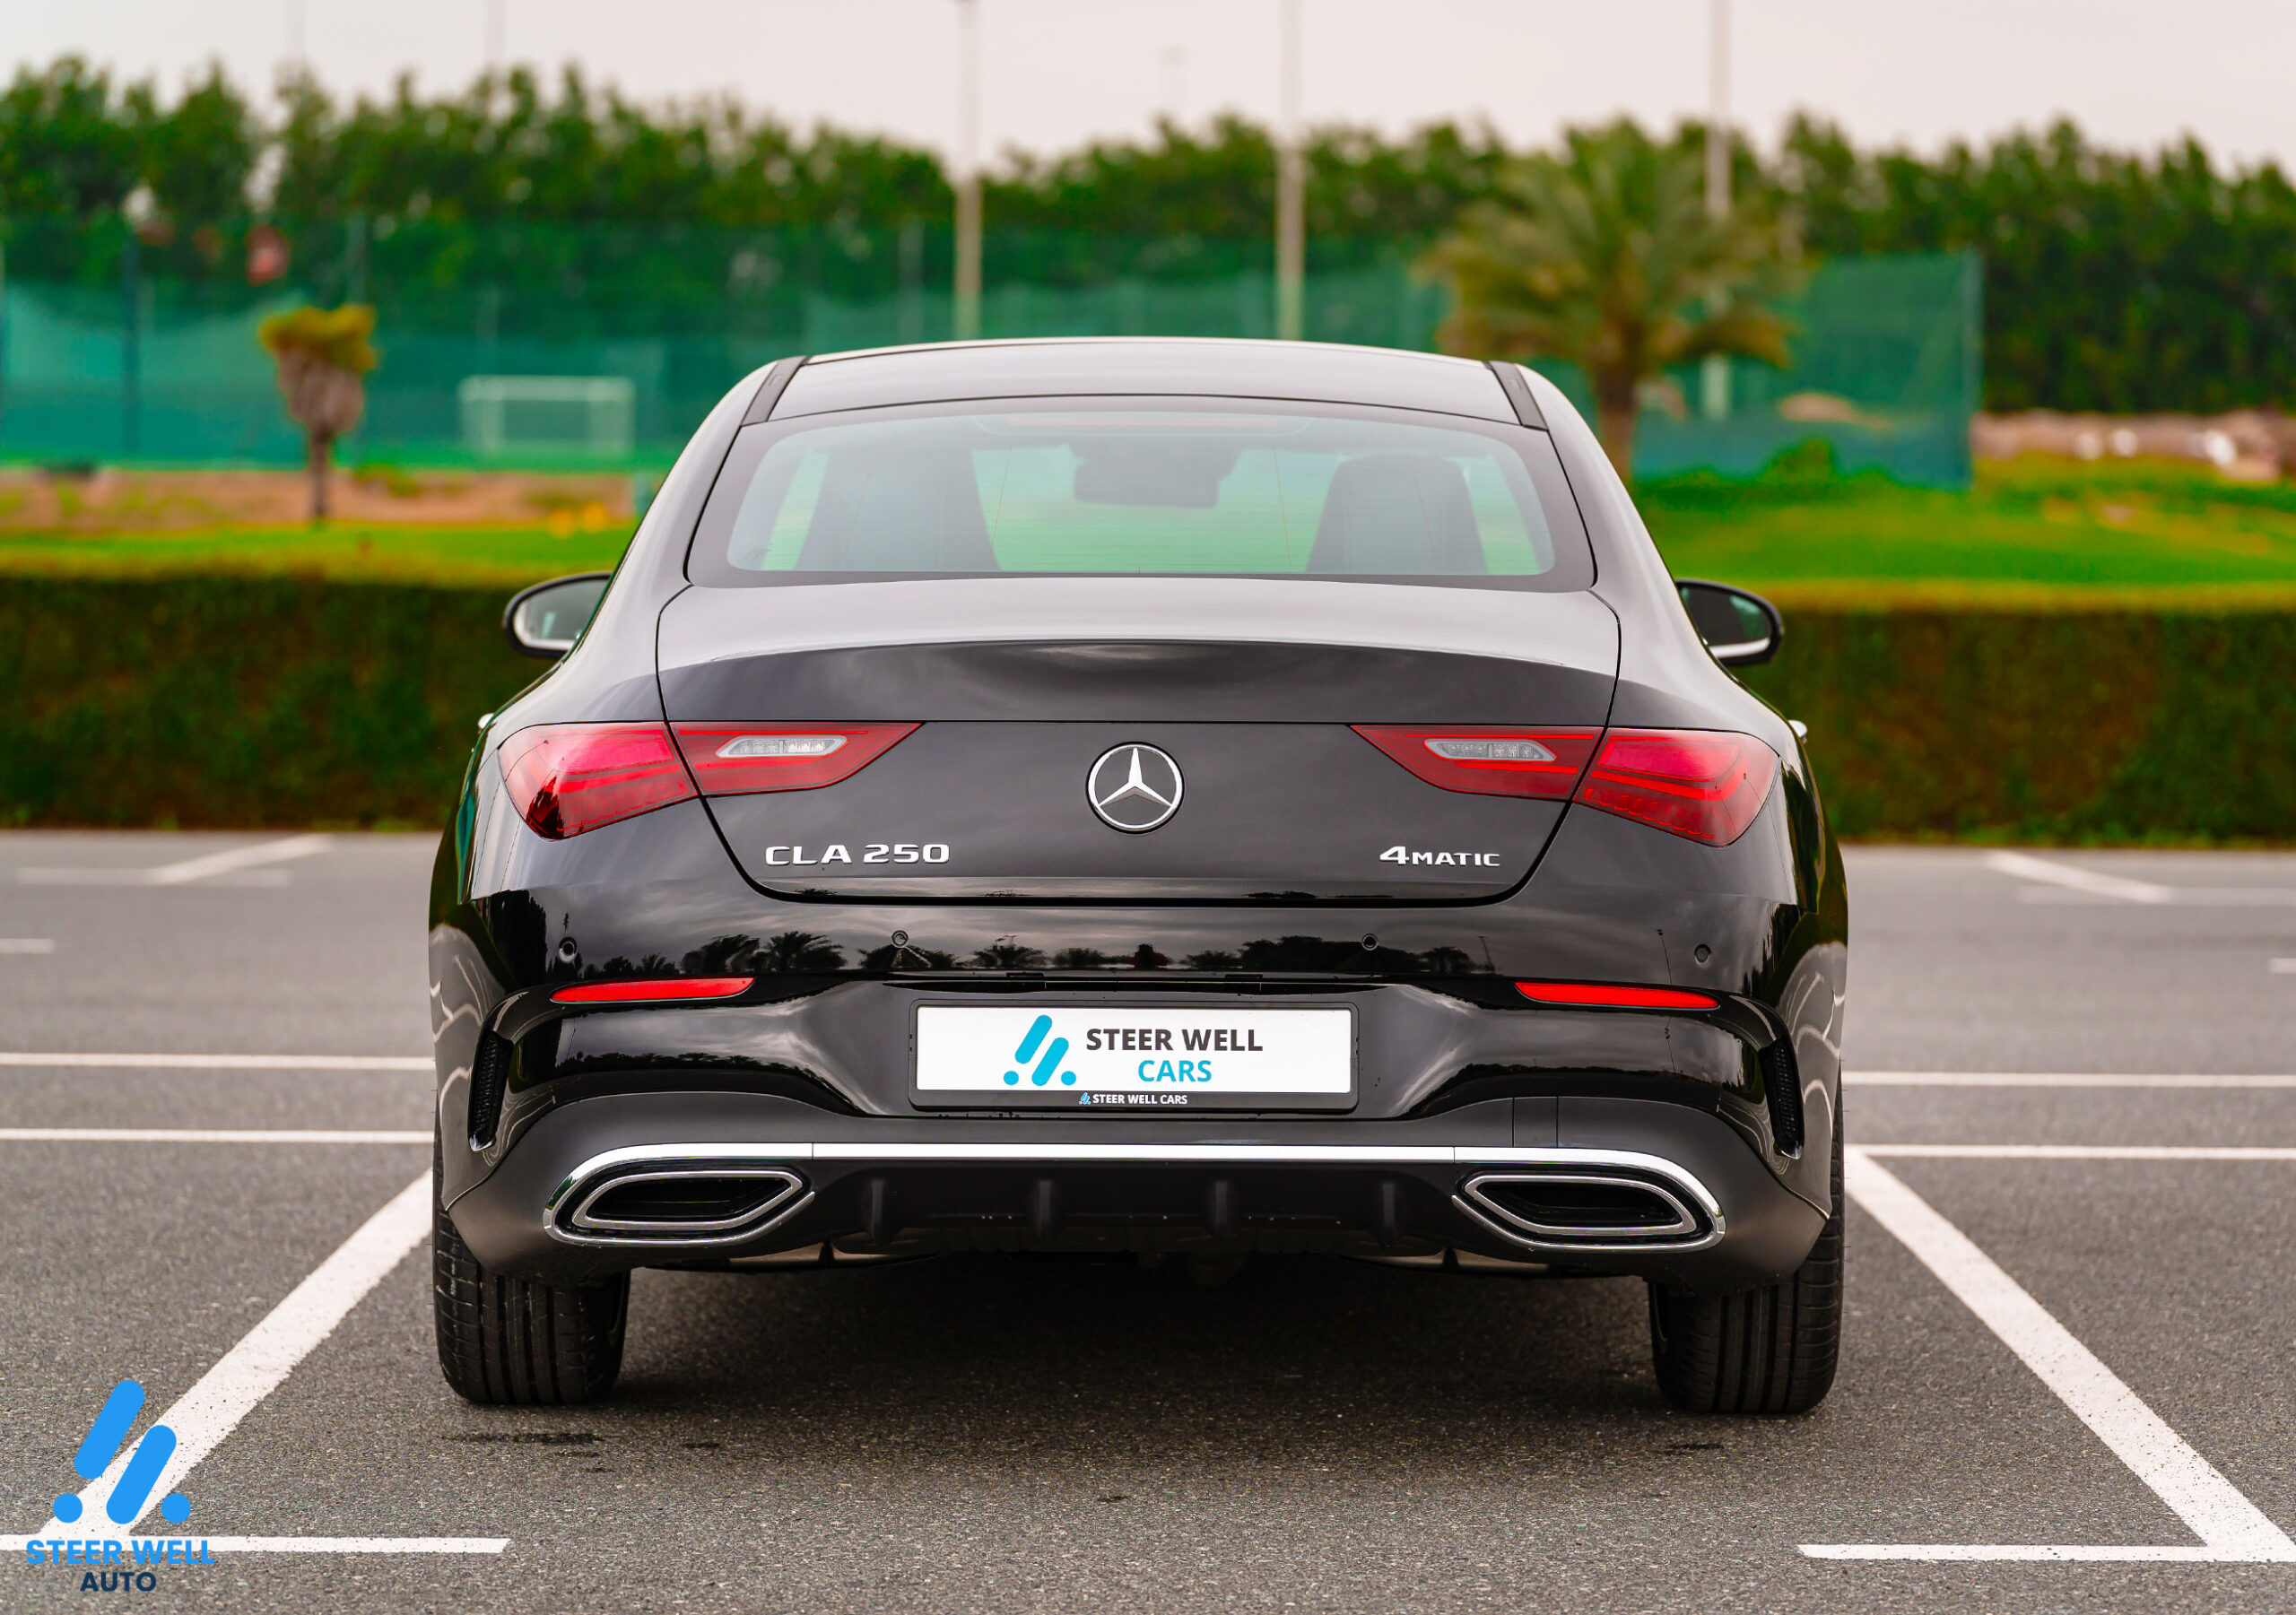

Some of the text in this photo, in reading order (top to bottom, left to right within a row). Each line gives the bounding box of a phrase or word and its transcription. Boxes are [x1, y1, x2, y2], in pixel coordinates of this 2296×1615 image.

[765, 844, 950, 865] CLA 250
[1379, 846, 1500, 866] 4MATIC
[1086, 1029, 1263, 1051] STEER WELL
[1138, 1060, 1212, 1082] CARS
[1092, 1093, 1188, 1105] STEER WELL CARS
